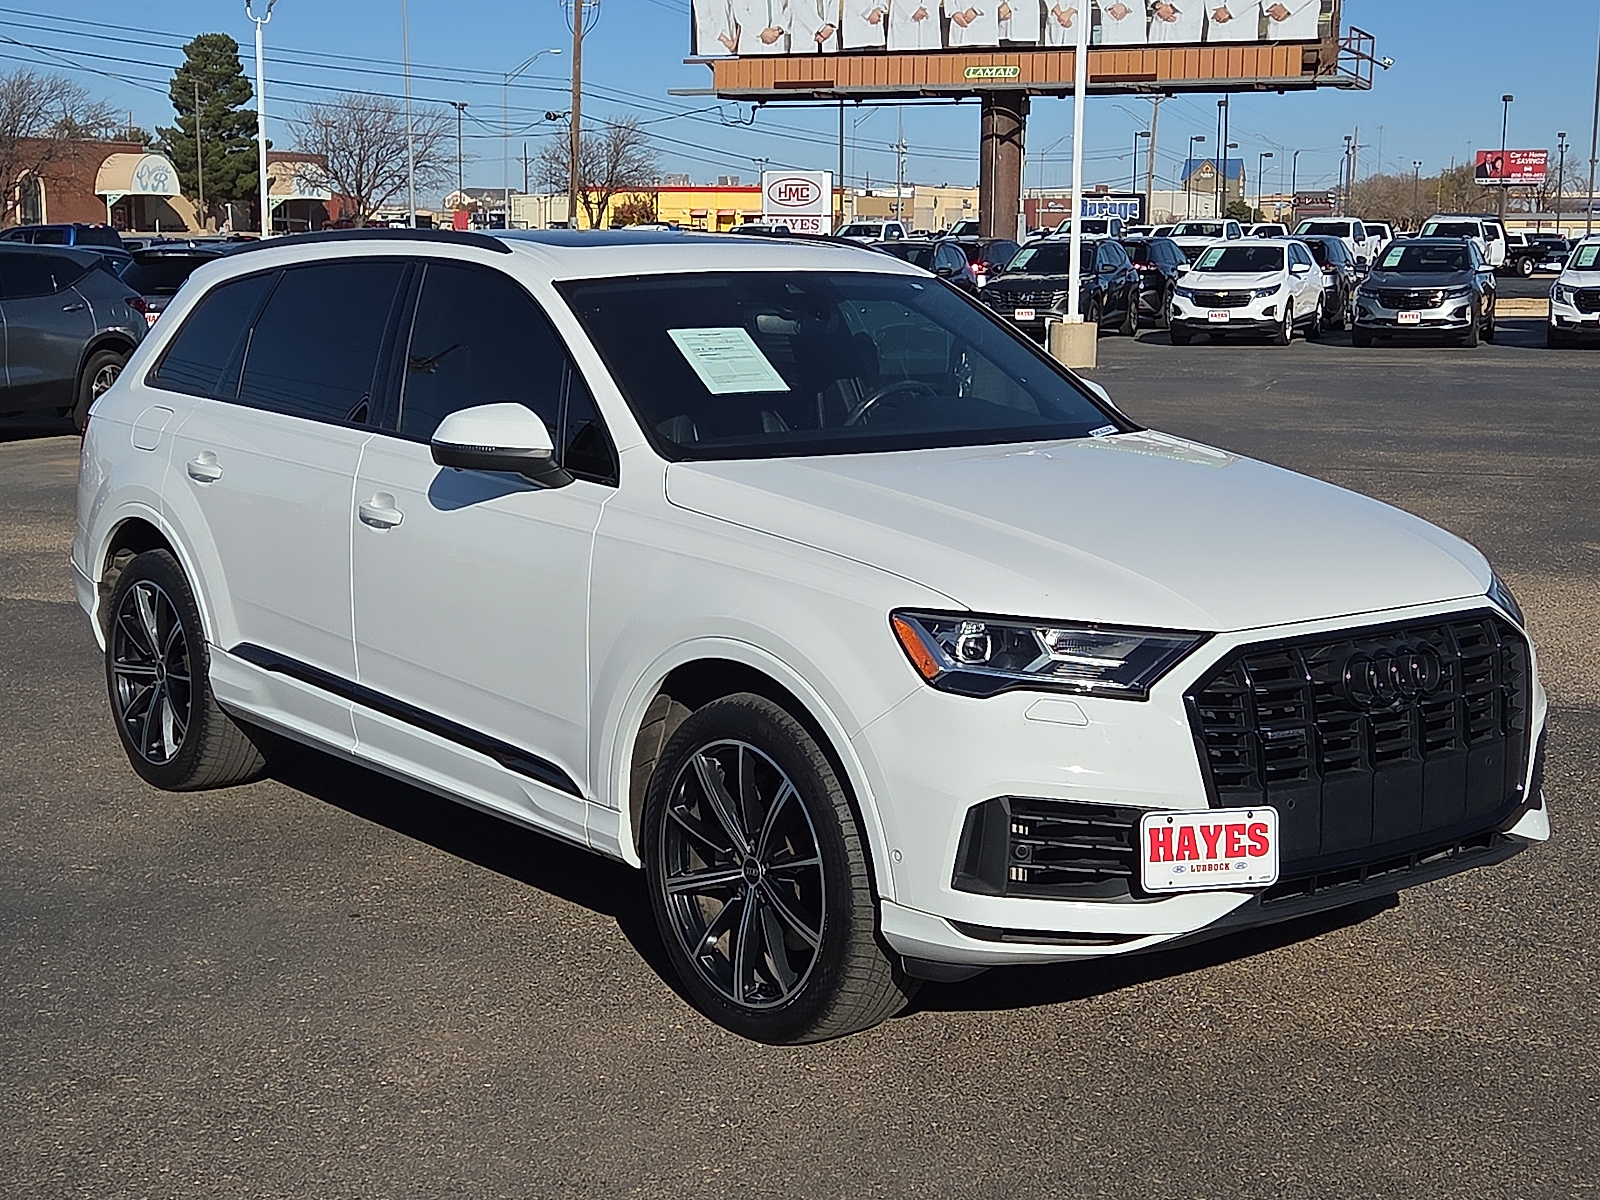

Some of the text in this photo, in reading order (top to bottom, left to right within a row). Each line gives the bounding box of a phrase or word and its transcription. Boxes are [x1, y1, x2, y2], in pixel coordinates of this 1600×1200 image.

[968, 68, 1016, 78] LAMAR
[778, 184, 809, 201] HMC
[1149, 823, 1269, 862] HAYES
[1190, 862, 1231, 872] LUBBOCK
